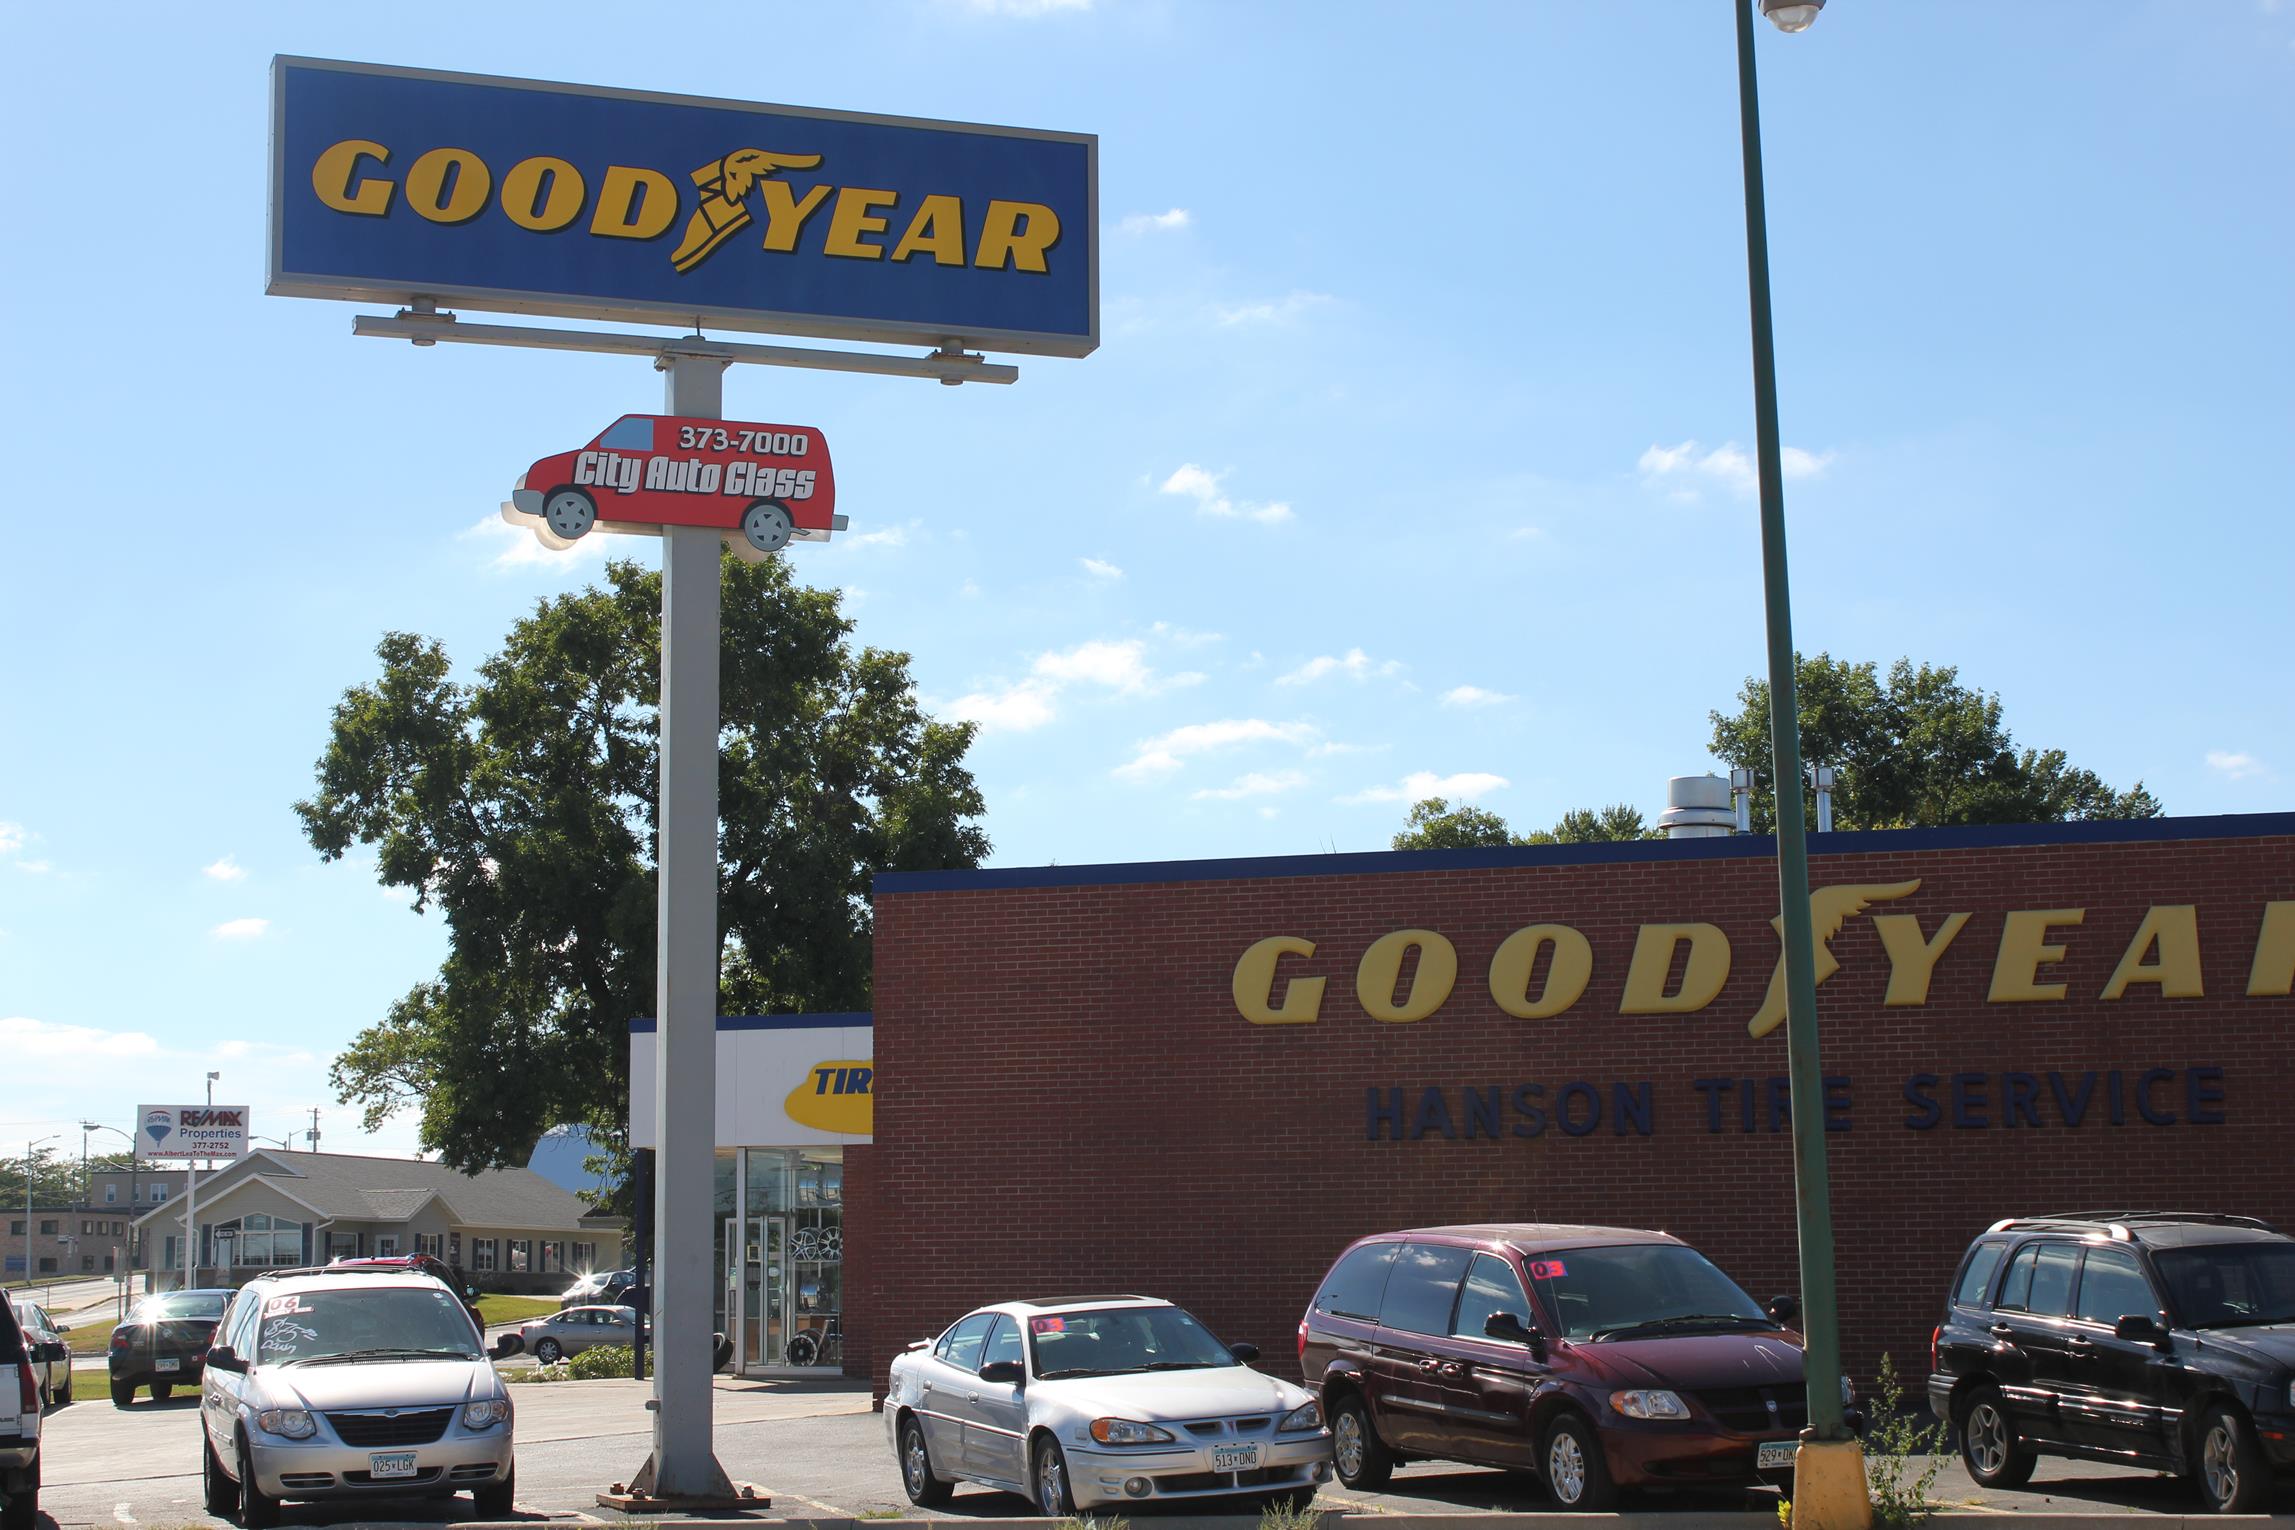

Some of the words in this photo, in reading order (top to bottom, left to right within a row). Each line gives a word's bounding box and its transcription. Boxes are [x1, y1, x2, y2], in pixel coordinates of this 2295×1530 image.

[679, 426, 809, 456] 373-7000
[574, 451, 642, 493] City
[645, 456, 722, 493] Auto
[724, 461, 816, 499] Glass
[815, 1067, 873, 1095] TIR
[1367, 1082, 1653, 1140] HANSON
[1694, 1075, 1852, 1133] TIRE
[1903, 1066, 2226, 1130] SERVICE
[180, 1109, 242, 1127] RE/MAX
[180, 1128, 241, 1140] Properties
[147, 1150, 237, 1158] www.AlbertLeaToTheMax.com
[270, 1297, 297, 1310] 06
